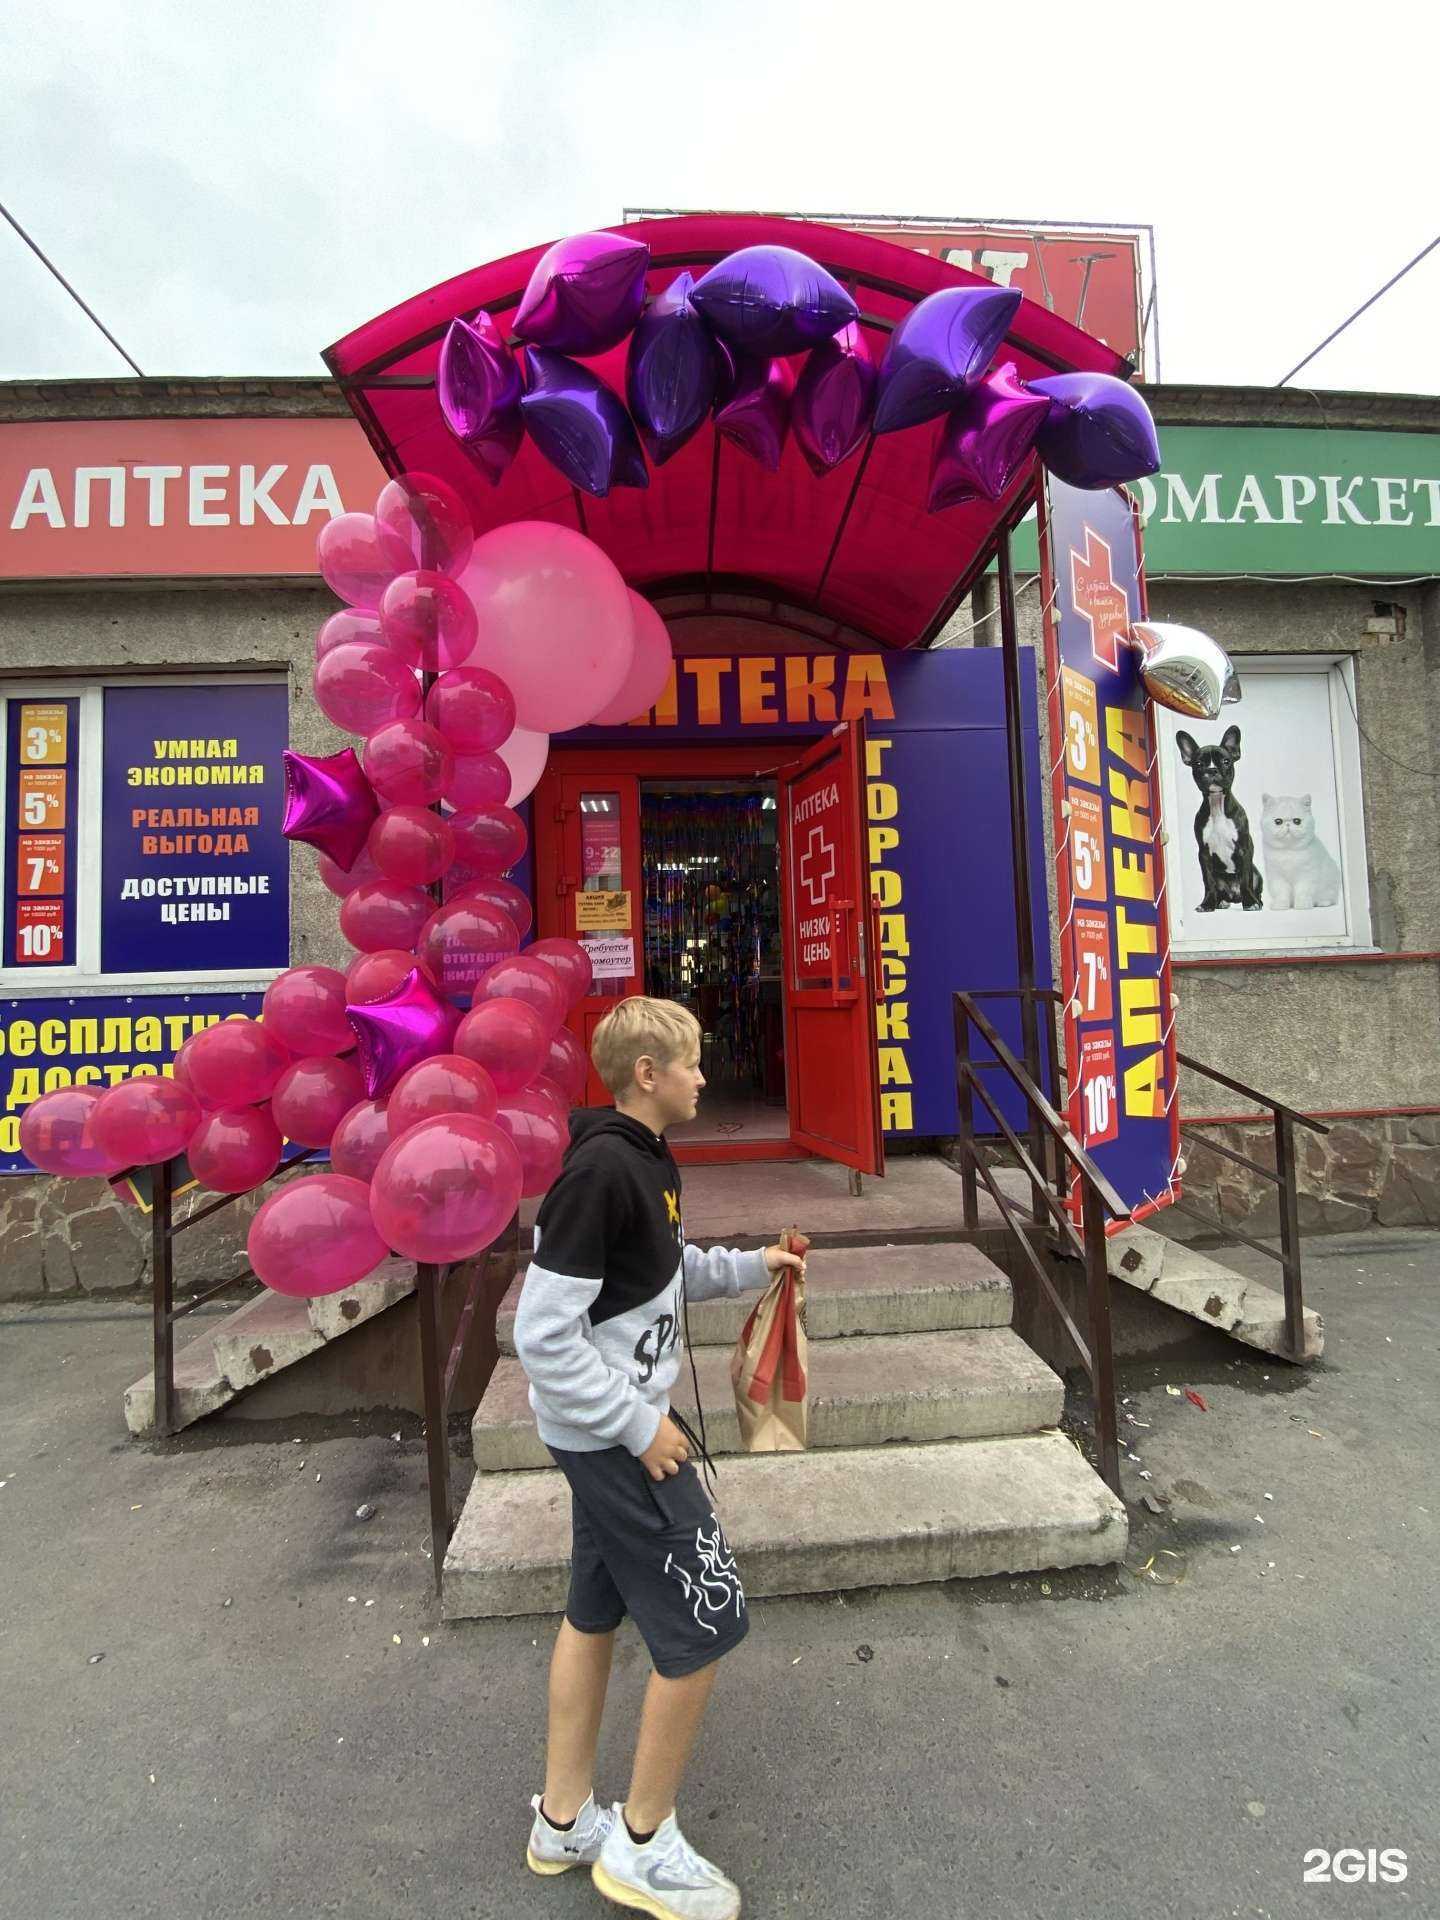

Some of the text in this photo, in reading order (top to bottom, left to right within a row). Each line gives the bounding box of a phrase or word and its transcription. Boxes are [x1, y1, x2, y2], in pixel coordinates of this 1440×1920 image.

[10, 464, 346, 529] АПТЕКА
[27, 727, 61, 760] 3%
[154, 740, 238, 758] УМНАЯ
[1070, 711, 1095, 771] 3%
[127, 765, 264, 785] ЭКОНОМИЯ
[24, 792, 59, 824] 5%
[132, 807, 259, 827] РЕАЛЬНАЯ
[794, 783, 840, 825] АПТЕКА
[142, 834, 249, 855] ВЫГОДА
[1074, 830, 1100, 890] 5%
[27, 858, 58, 890] 7%
[121, 876, 269, 899] ДОСТУПНЫЕ
[161, 903, 230, 924] ЦЕНЫ
[1105, 706, 1167, 1117] АПТЕКА
[19, 924, 63, 956] 10%
[865, 740, 914, 1130] ГОРОДСКАЯ
[1083, 952, 1107, 1011] 7%
[1085, 1074, 1117, 1135] 10%
